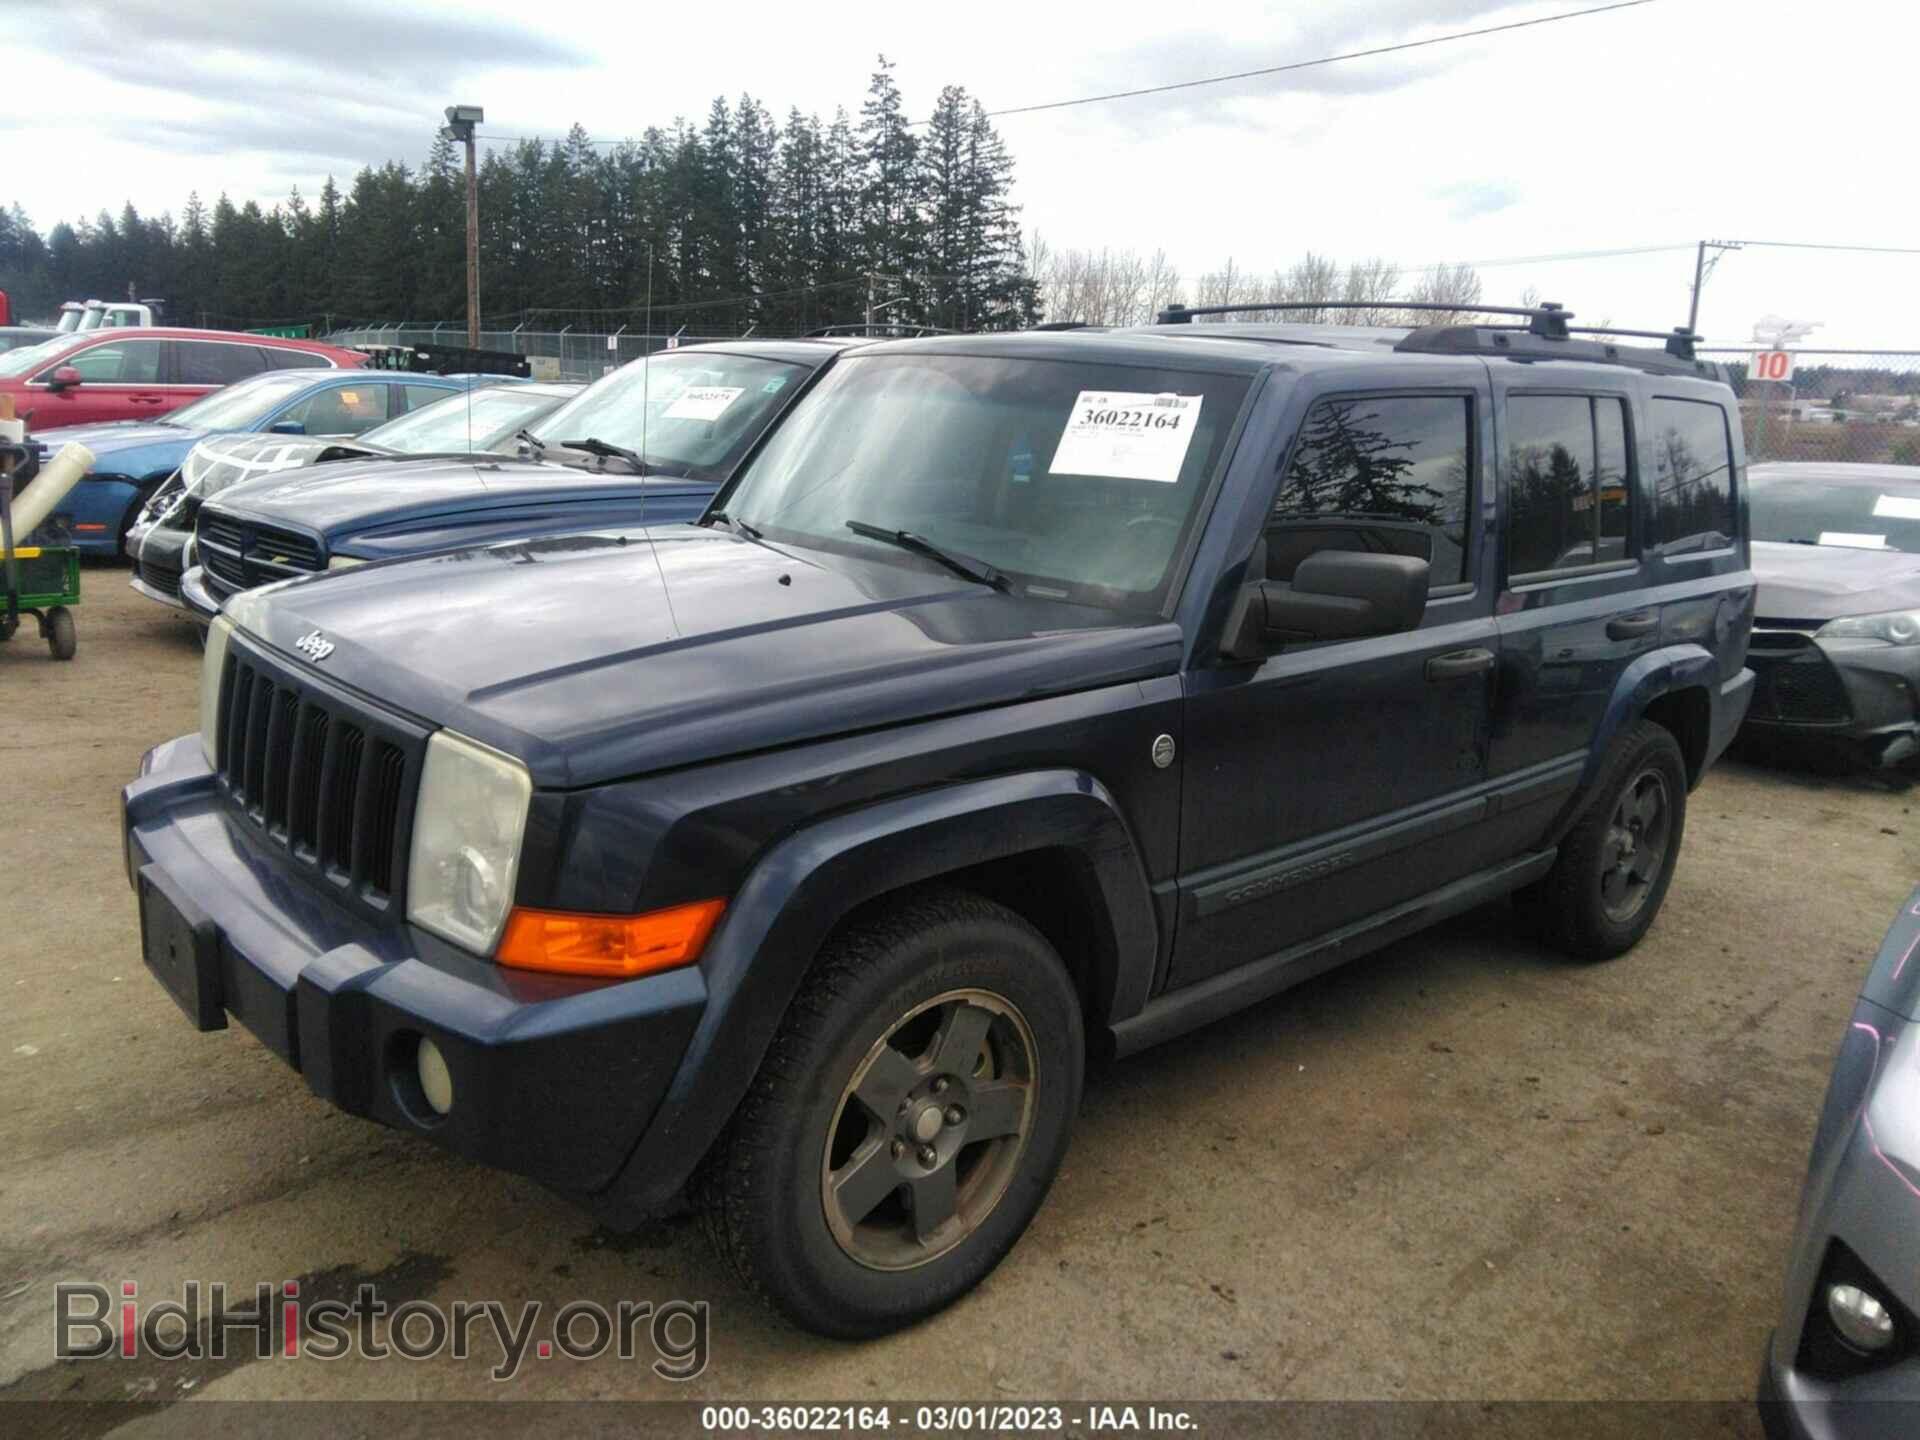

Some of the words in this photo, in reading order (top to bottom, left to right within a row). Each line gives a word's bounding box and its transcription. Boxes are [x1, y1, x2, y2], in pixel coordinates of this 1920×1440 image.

[1757, 352, 1788, 379] 10
[1080, 409, 1181, 430] 36022164
[295, 629, 335, 661] Jeep
